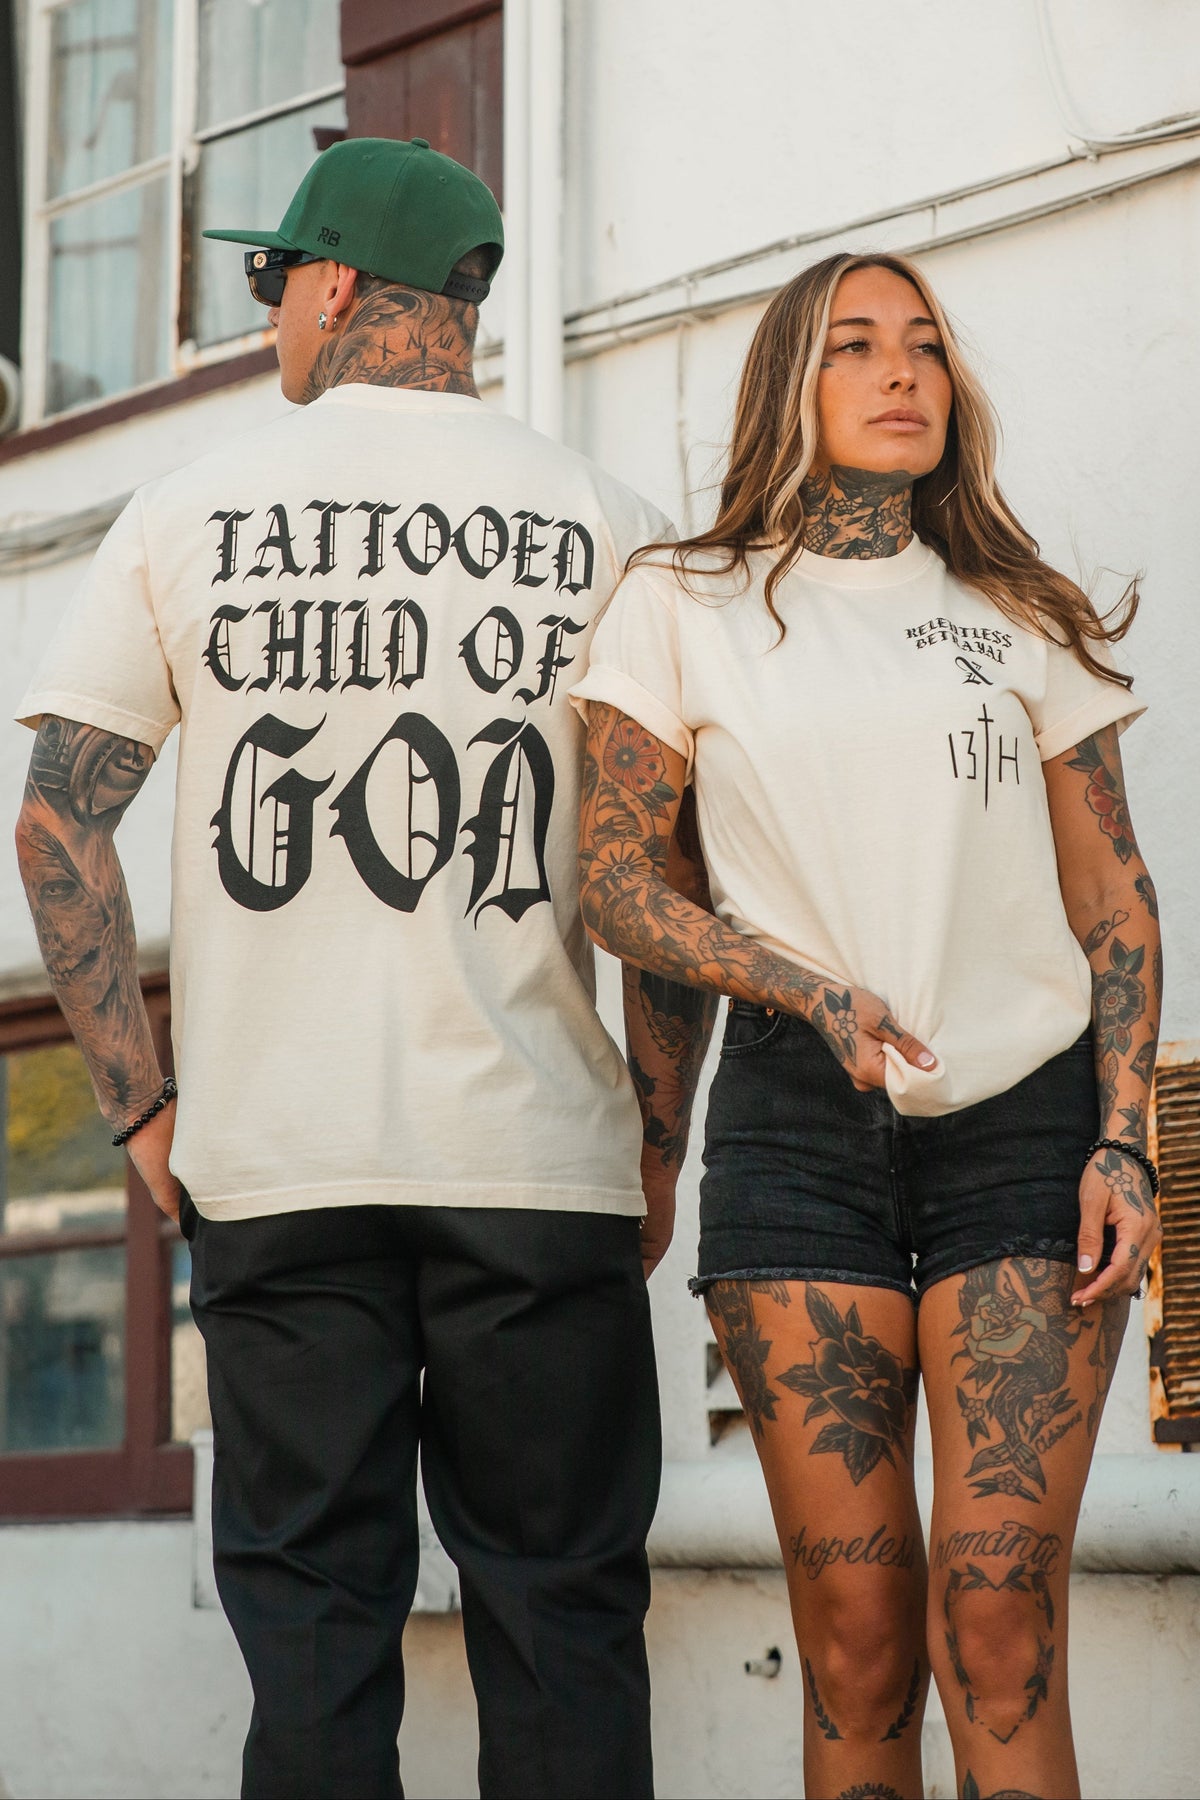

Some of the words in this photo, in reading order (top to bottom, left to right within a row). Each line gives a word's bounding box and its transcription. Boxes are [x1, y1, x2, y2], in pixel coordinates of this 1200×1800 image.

[316, 226, 341, 247] RB
[204, 499, 595, 596] TATTOOED
[201, 597, 429, 695] CHILD
[458, 605, 589, 706] OF
[904, 617, 1013, 648] RELENTLESS
[915, 630, 1005, 665] BETRAYAL
[209, 711, 555, 931] GOD
